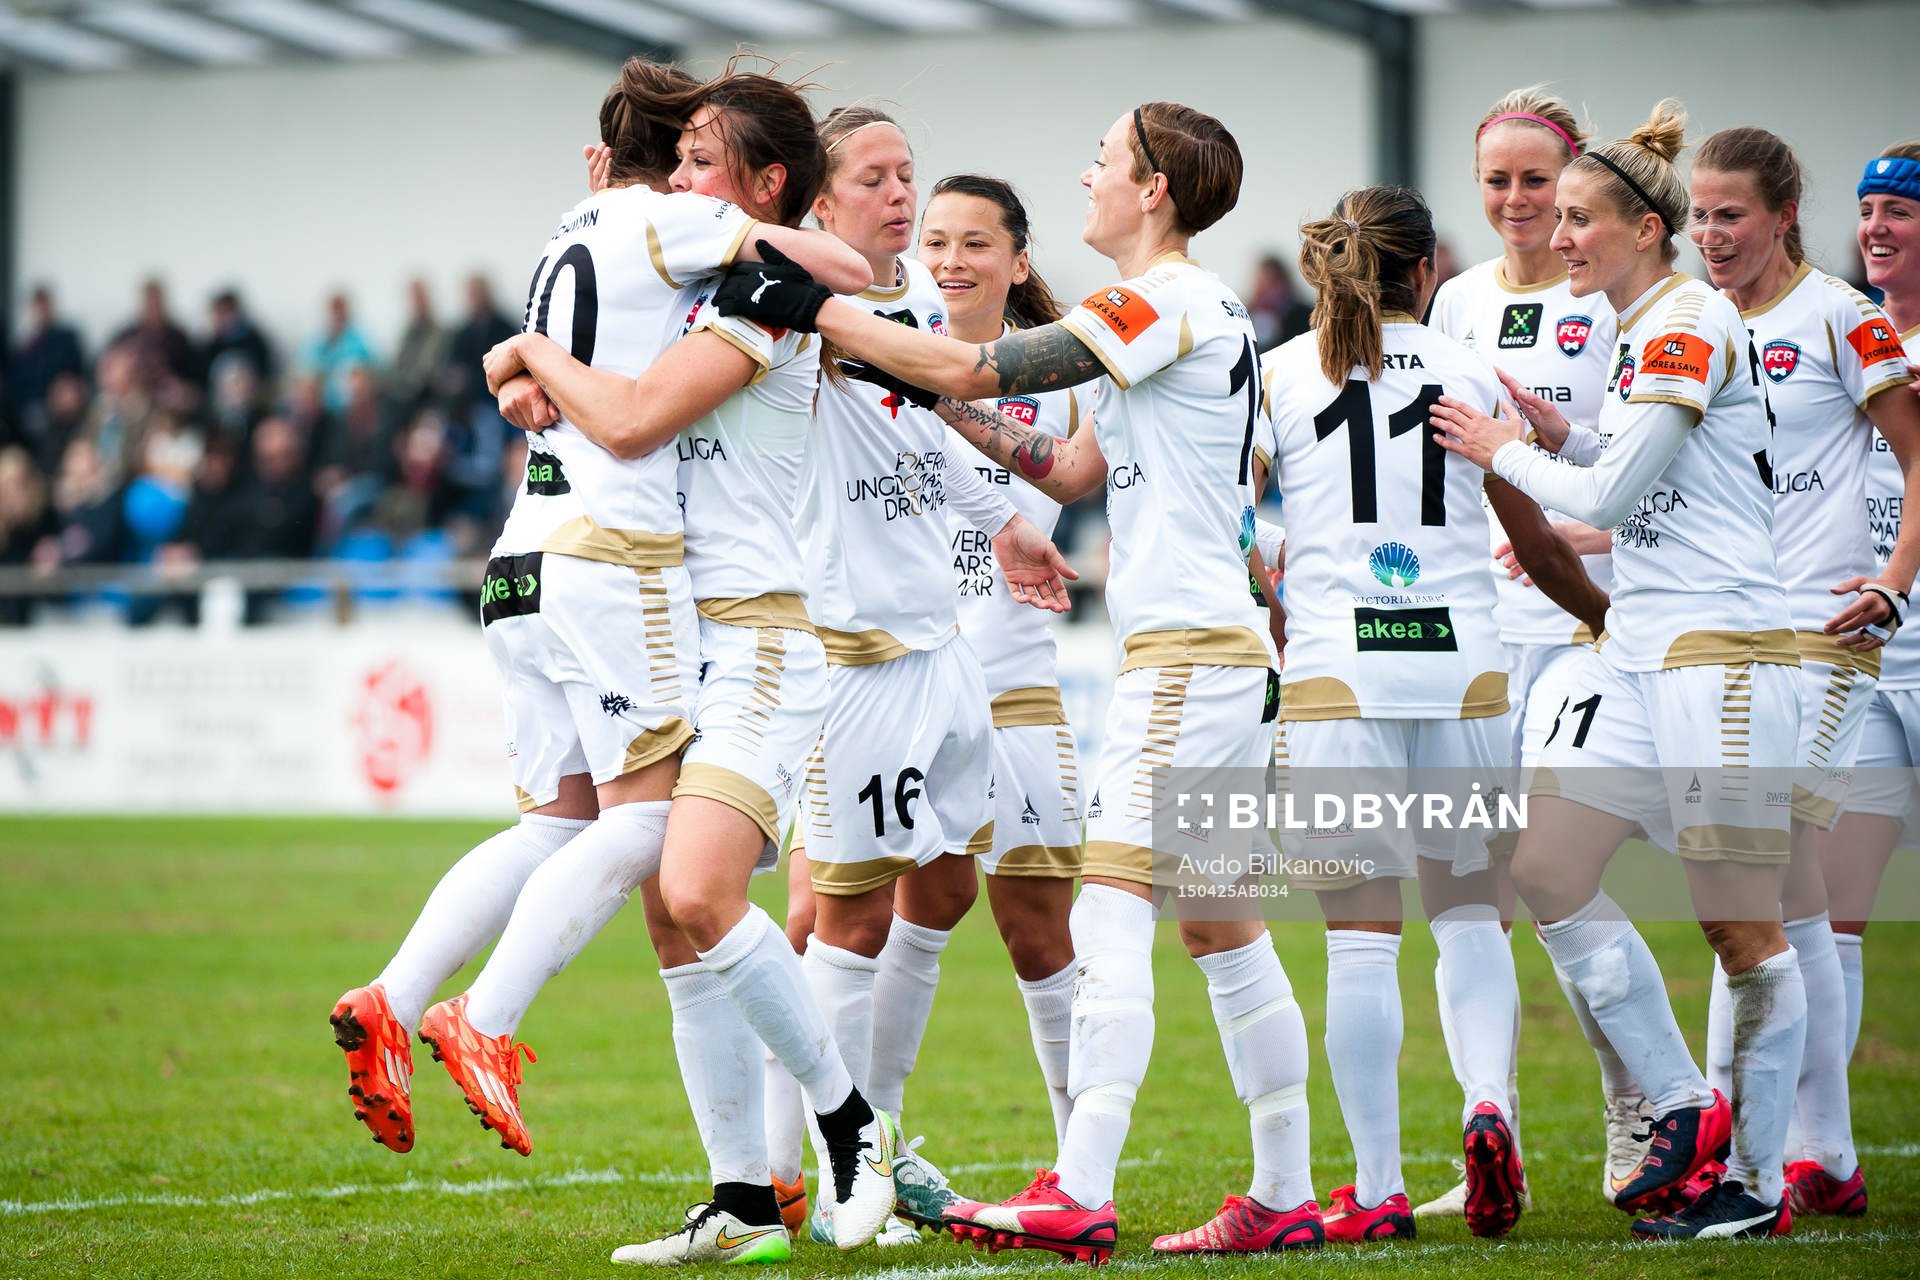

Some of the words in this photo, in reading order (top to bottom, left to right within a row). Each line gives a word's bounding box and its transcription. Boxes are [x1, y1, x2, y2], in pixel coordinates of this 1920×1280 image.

[1101, 306, 1110, 314] &
[1107, 311, 1129, 332] SAVE
[1559, 325, 1588, 338] FCR
[1501, 336, 1535, 346] MIKZ
[1382, 354, 1425, 369] RTA
[1765, 350, 1794, 362] FCR
[1669, 360, 1676, 369] &
[1677, 361, 1700, 375] SAVE
[1533, 386, 1572, 402] ma
[1003, 405, 1033, 420] FCR
[1314, 380, 1446, 526] 11
[1773, 470, 1825, 495] LIGA
[953, 554, 992, 576] ARS
[1352, 595, 1412, 605] VICTORIA
[1358, 618, 1423, 639] akea
[858, 766, 924, 838] 16
